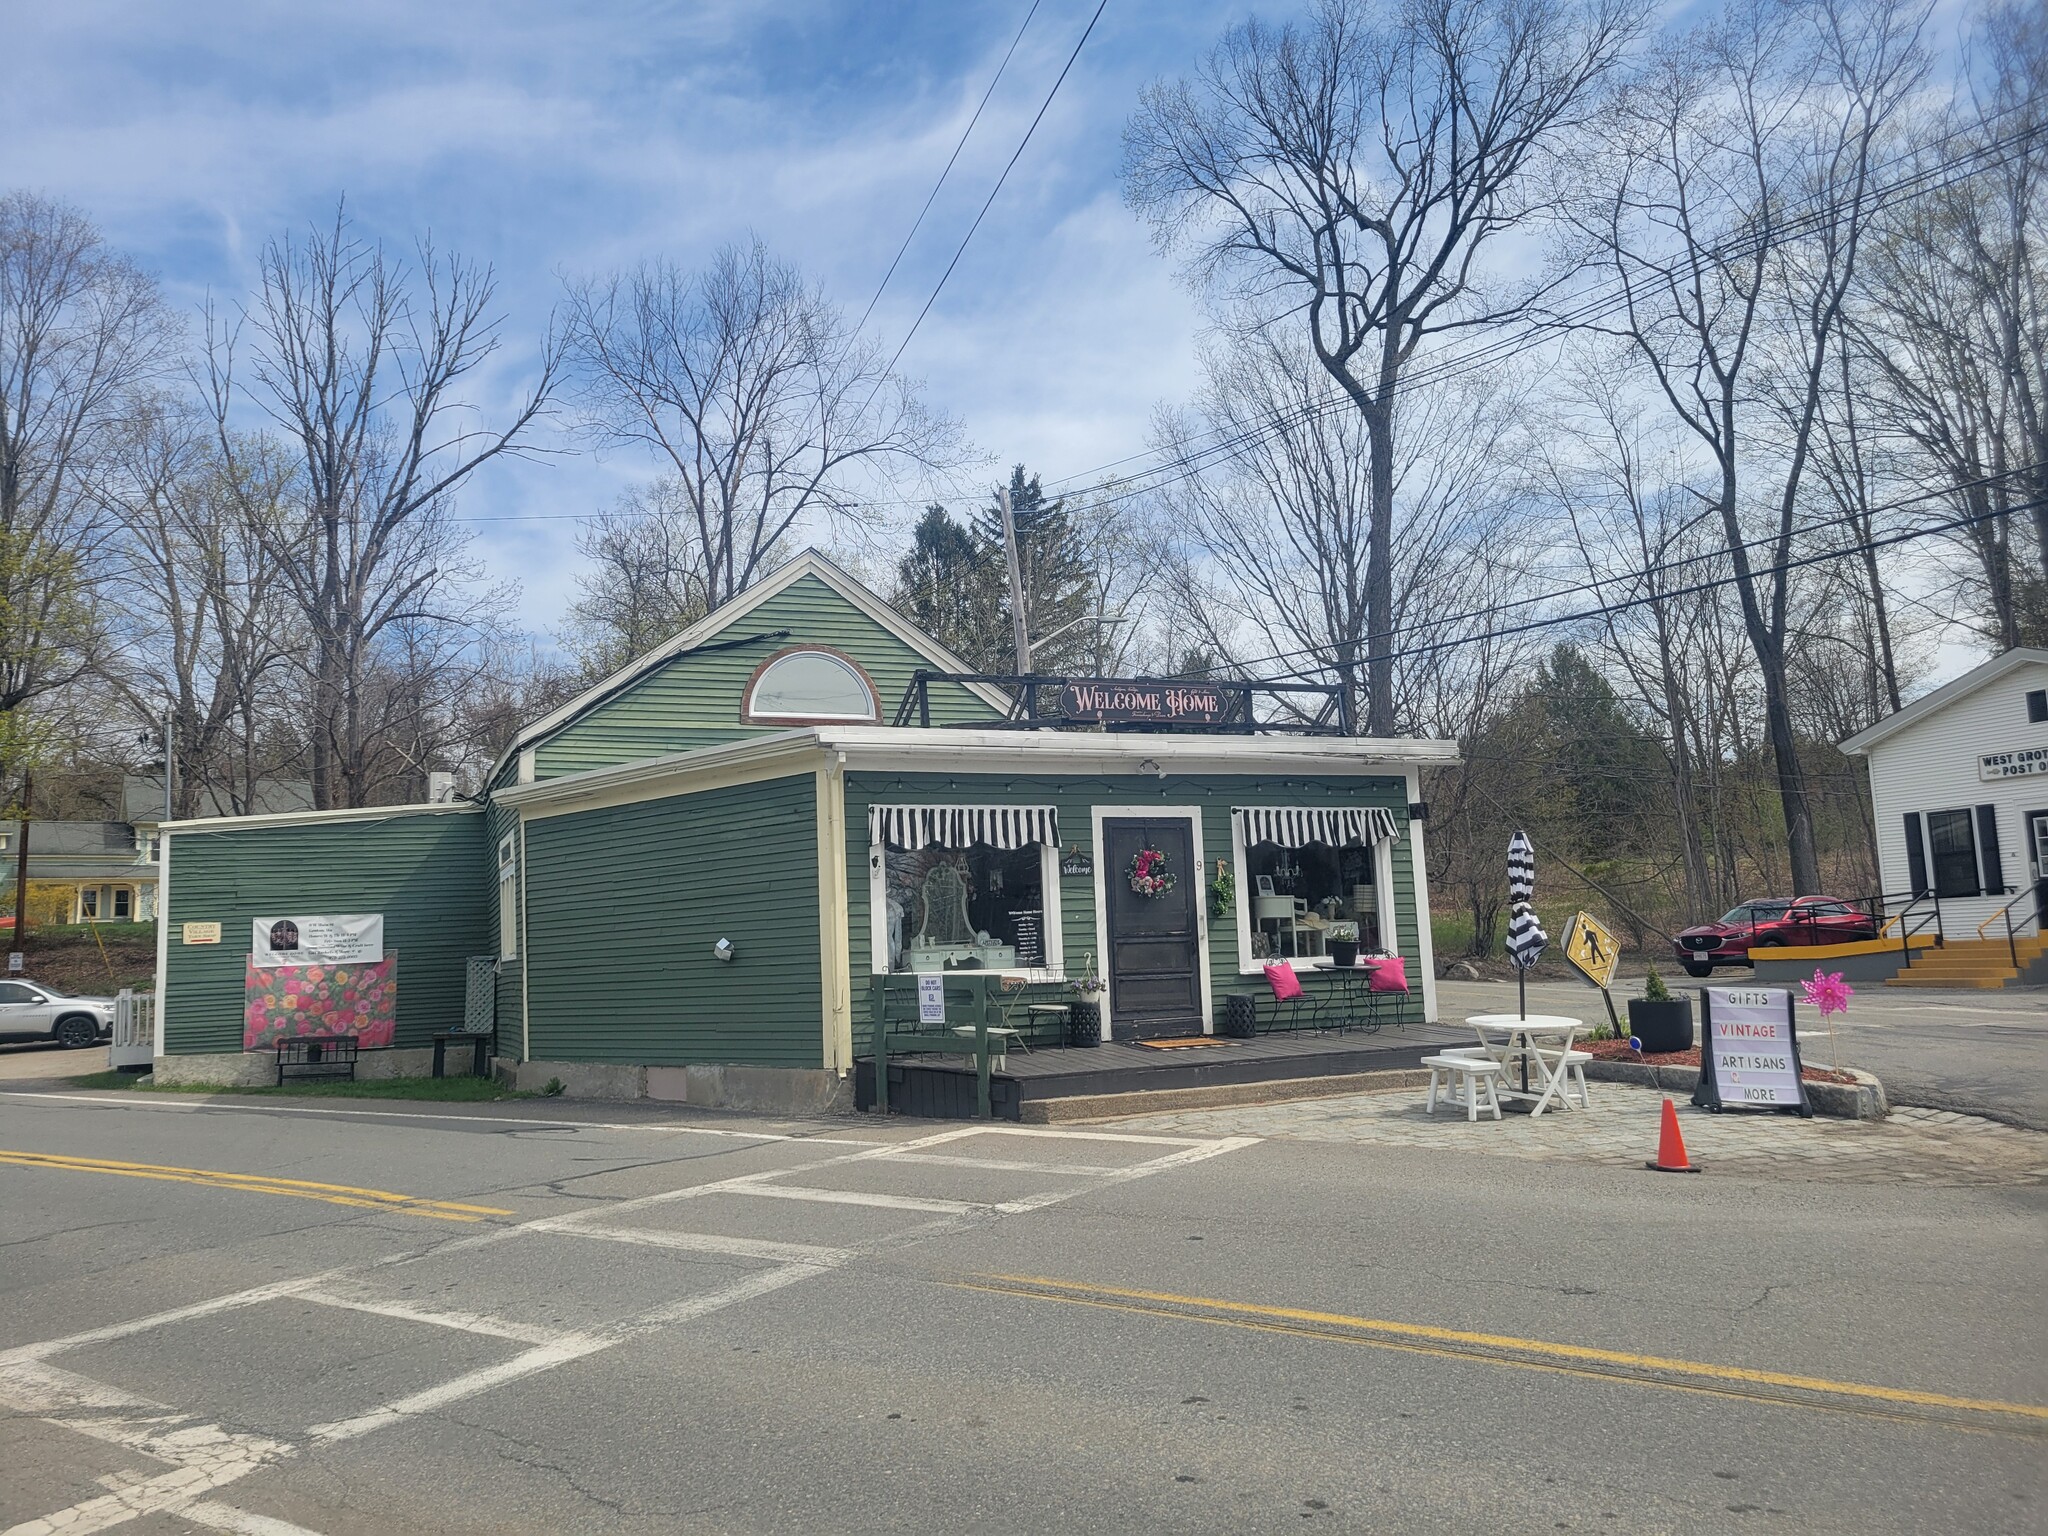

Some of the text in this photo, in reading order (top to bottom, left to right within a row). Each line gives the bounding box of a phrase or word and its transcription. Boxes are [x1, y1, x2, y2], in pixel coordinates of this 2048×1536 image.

[1070, 685, 1218, 717] WELCOME HOME
[1982, 754, 2013, 766] WEST
[2002, 761, 2048, 776] POST O
[1063, 864, 1092, 874] Welcome
[1196, 861, 1202, 871] 9
[1728, 993, 1768, 1005] GIFTS
[1720, 1024, 1776, 1037] VINTAGE
[1722, 1056, 1786, 1070] ARTISANS
[1744, 1088, 1775, 1100] MORE
